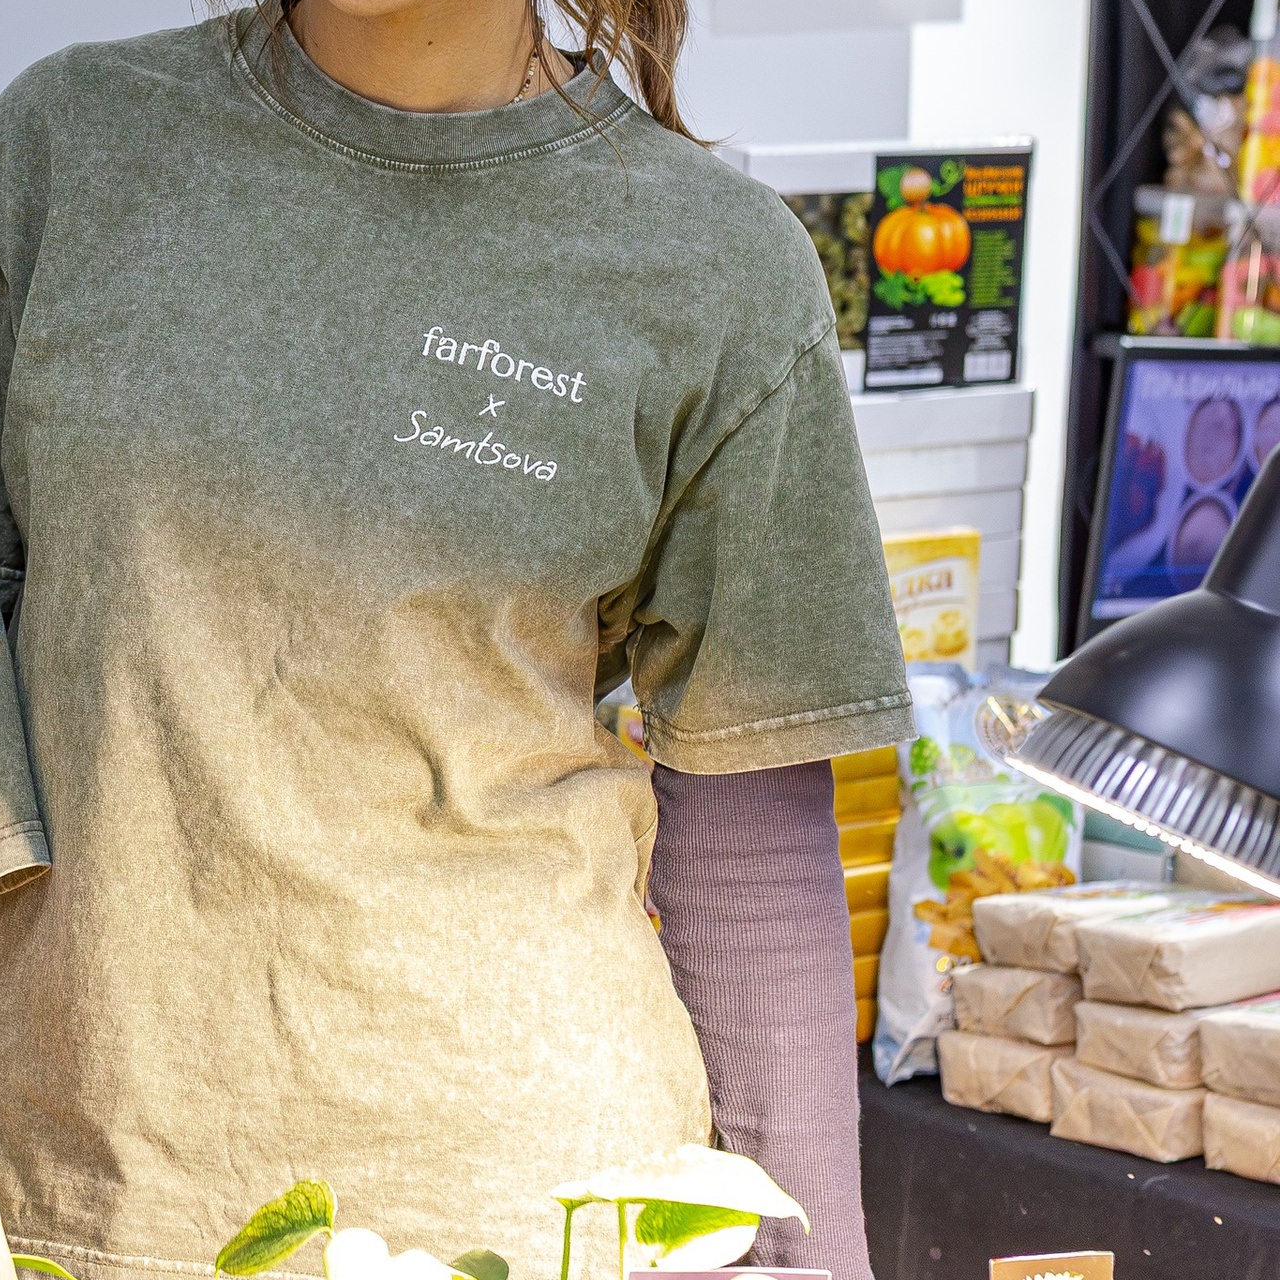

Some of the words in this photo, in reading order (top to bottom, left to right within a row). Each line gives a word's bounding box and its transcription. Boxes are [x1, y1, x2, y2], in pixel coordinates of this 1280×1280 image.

[422, 326, 587, 402] farforest
[478, 393, 506, 418] x
[393, 410, 558, 481] Samtsova
